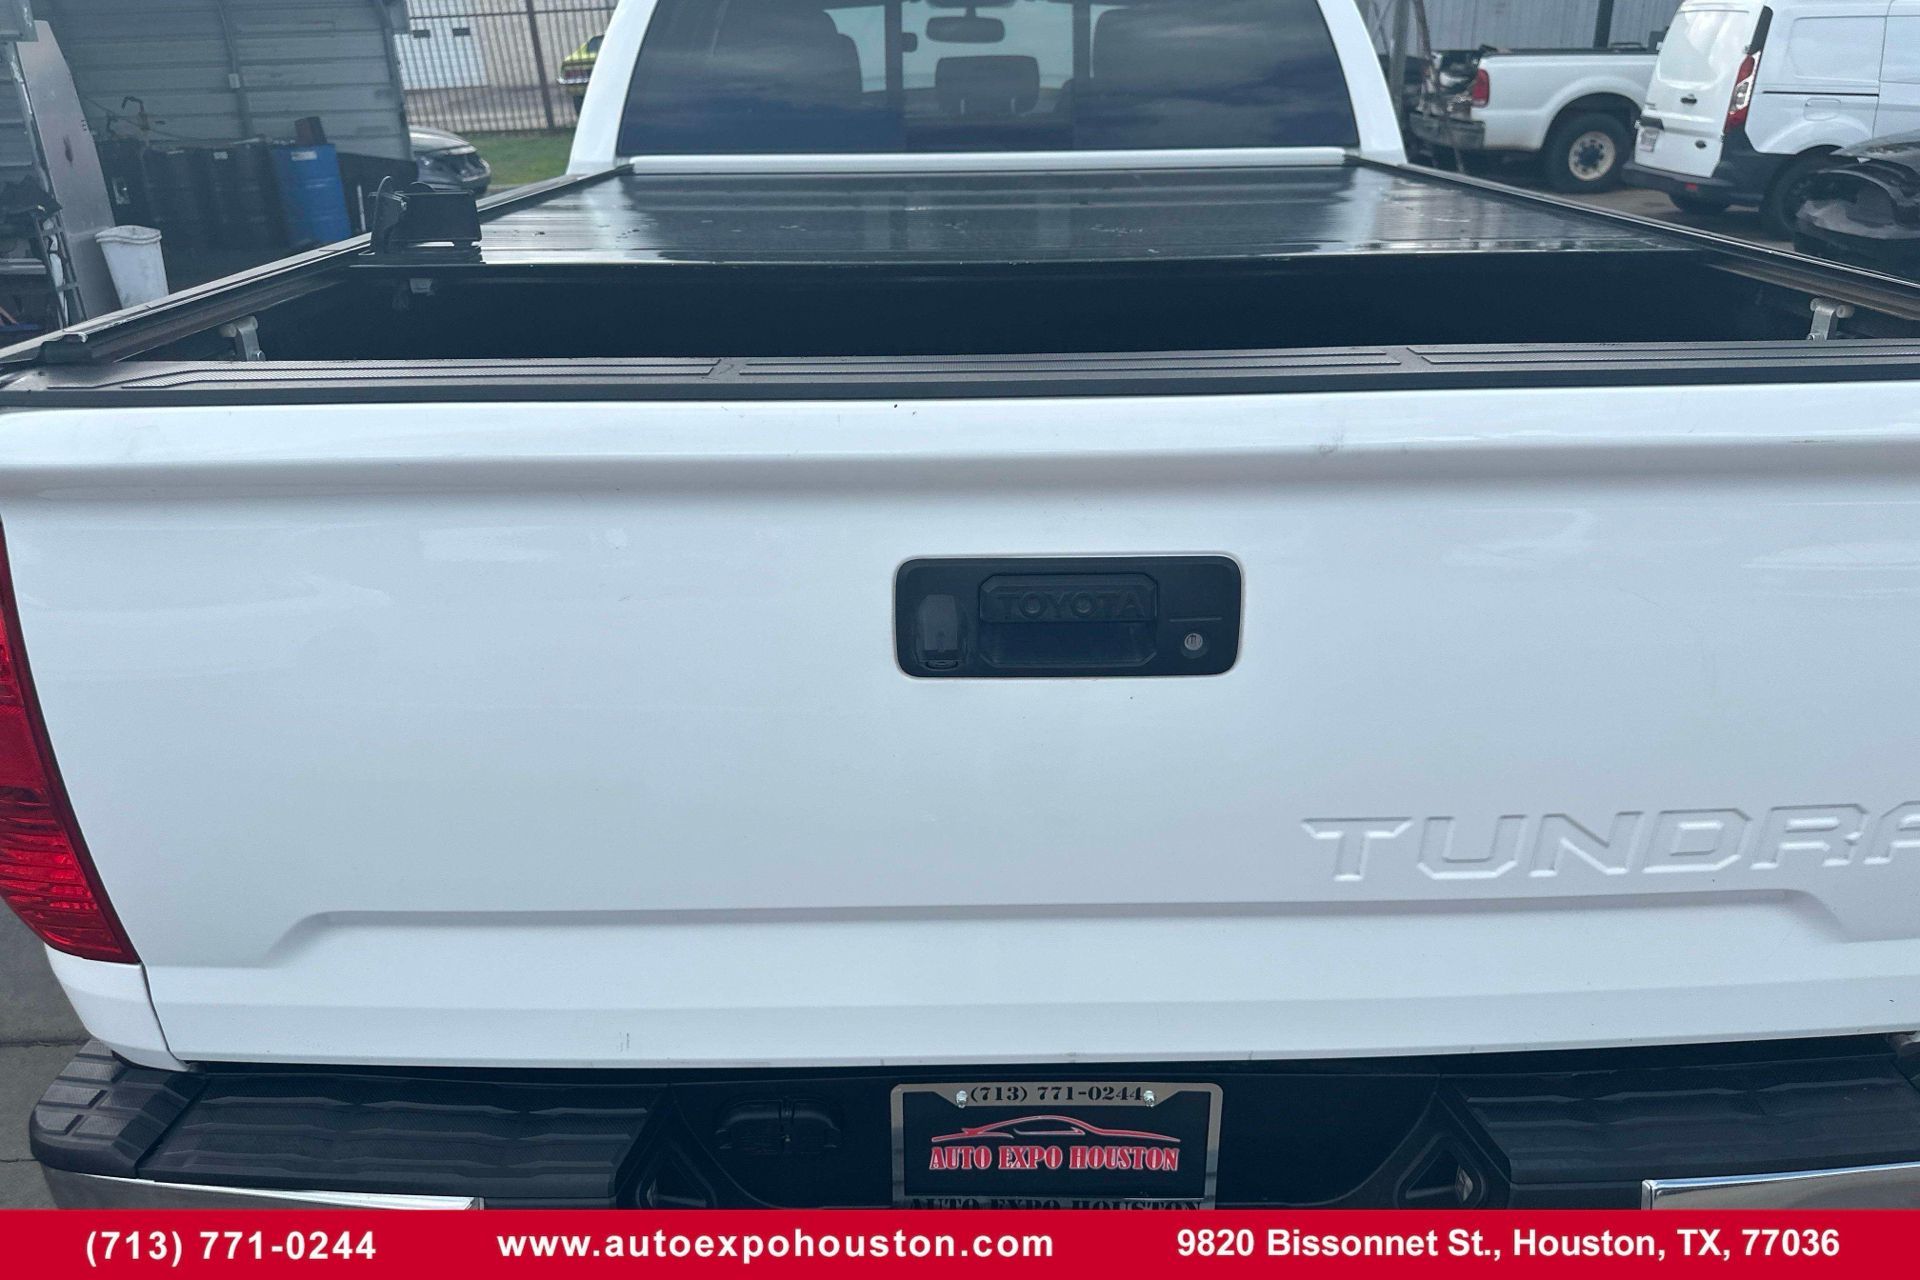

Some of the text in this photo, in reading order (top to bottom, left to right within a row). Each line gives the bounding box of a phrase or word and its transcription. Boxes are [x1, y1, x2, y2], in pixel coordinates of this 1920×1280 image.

[995, 590, 1146, 619] TOYOTA
[970, 1085, 1145, 1102] (713) 771-0244
[929, 1146, 1180, 1171] AUTO EXPO HOUSTON
